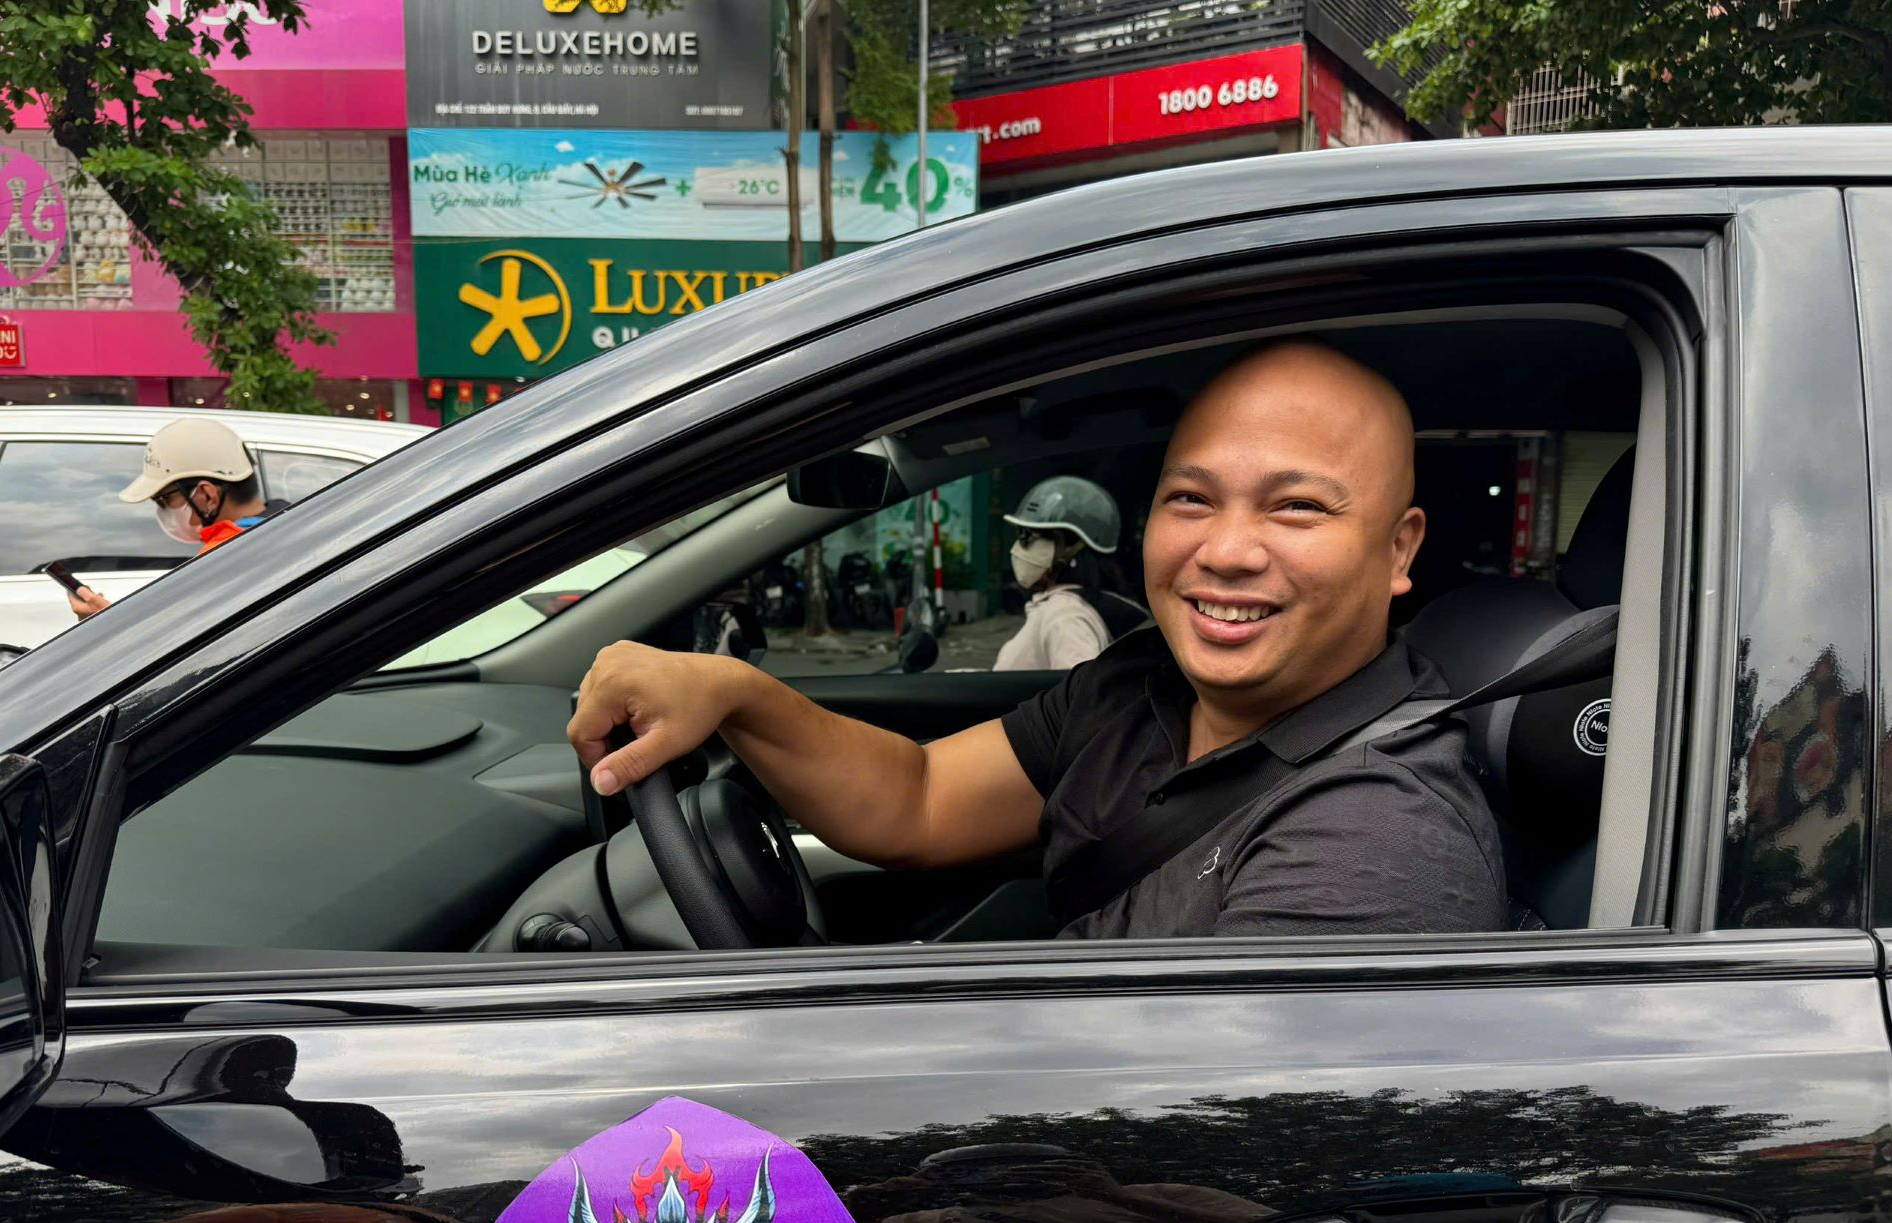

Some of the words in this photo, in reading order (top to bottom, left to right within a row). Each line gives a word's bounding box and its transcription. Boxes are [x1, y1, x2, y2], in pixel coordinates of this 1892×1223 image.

[472, 31, 698, 56] DELUXEHOME
[612, 63, 660, 76] TRUNG
[1157, 84, 1213, 115] 1800
[1217, 74, 1279, 106] 6886
[413, 165, 458, 183] Mùa
[464, 165, 491, 183] Hè
